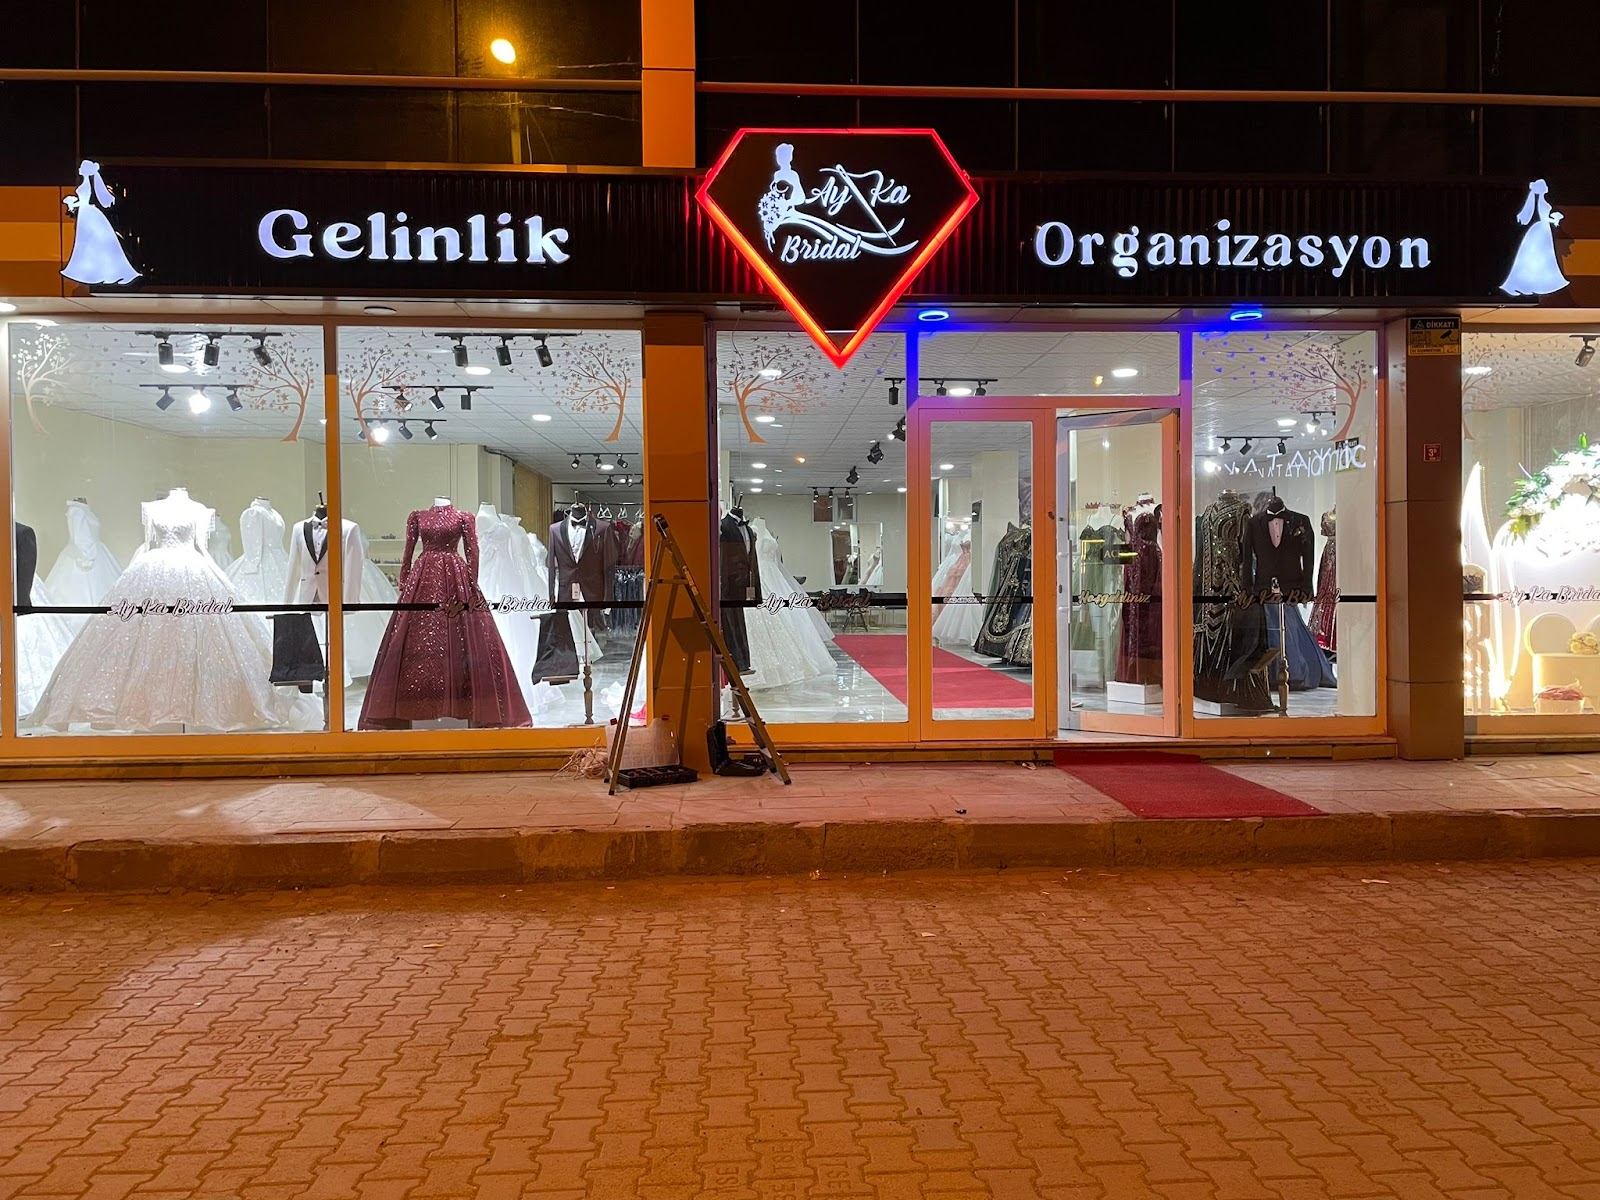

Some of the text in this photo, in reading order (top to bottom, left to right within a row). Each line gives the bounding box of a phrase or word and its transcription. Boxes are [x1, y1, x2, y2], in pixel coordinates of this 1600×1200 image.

[804, 175, 912, 216] Ay Ka
[257, 208, 571, 266] Gelinlik
[780, 234, 862, 265] Bridal
[1034, 218, 1432, 279] Organizasyon
[107, 596, 234, 621] Ay Ka Bridal
[497, 594, 556, 614] Bridal
[757, 592, 786, 615] Ay
[788, 591, 814, 610] Ka
[1498, 584, 1600, 608] Ay Ka Brida
